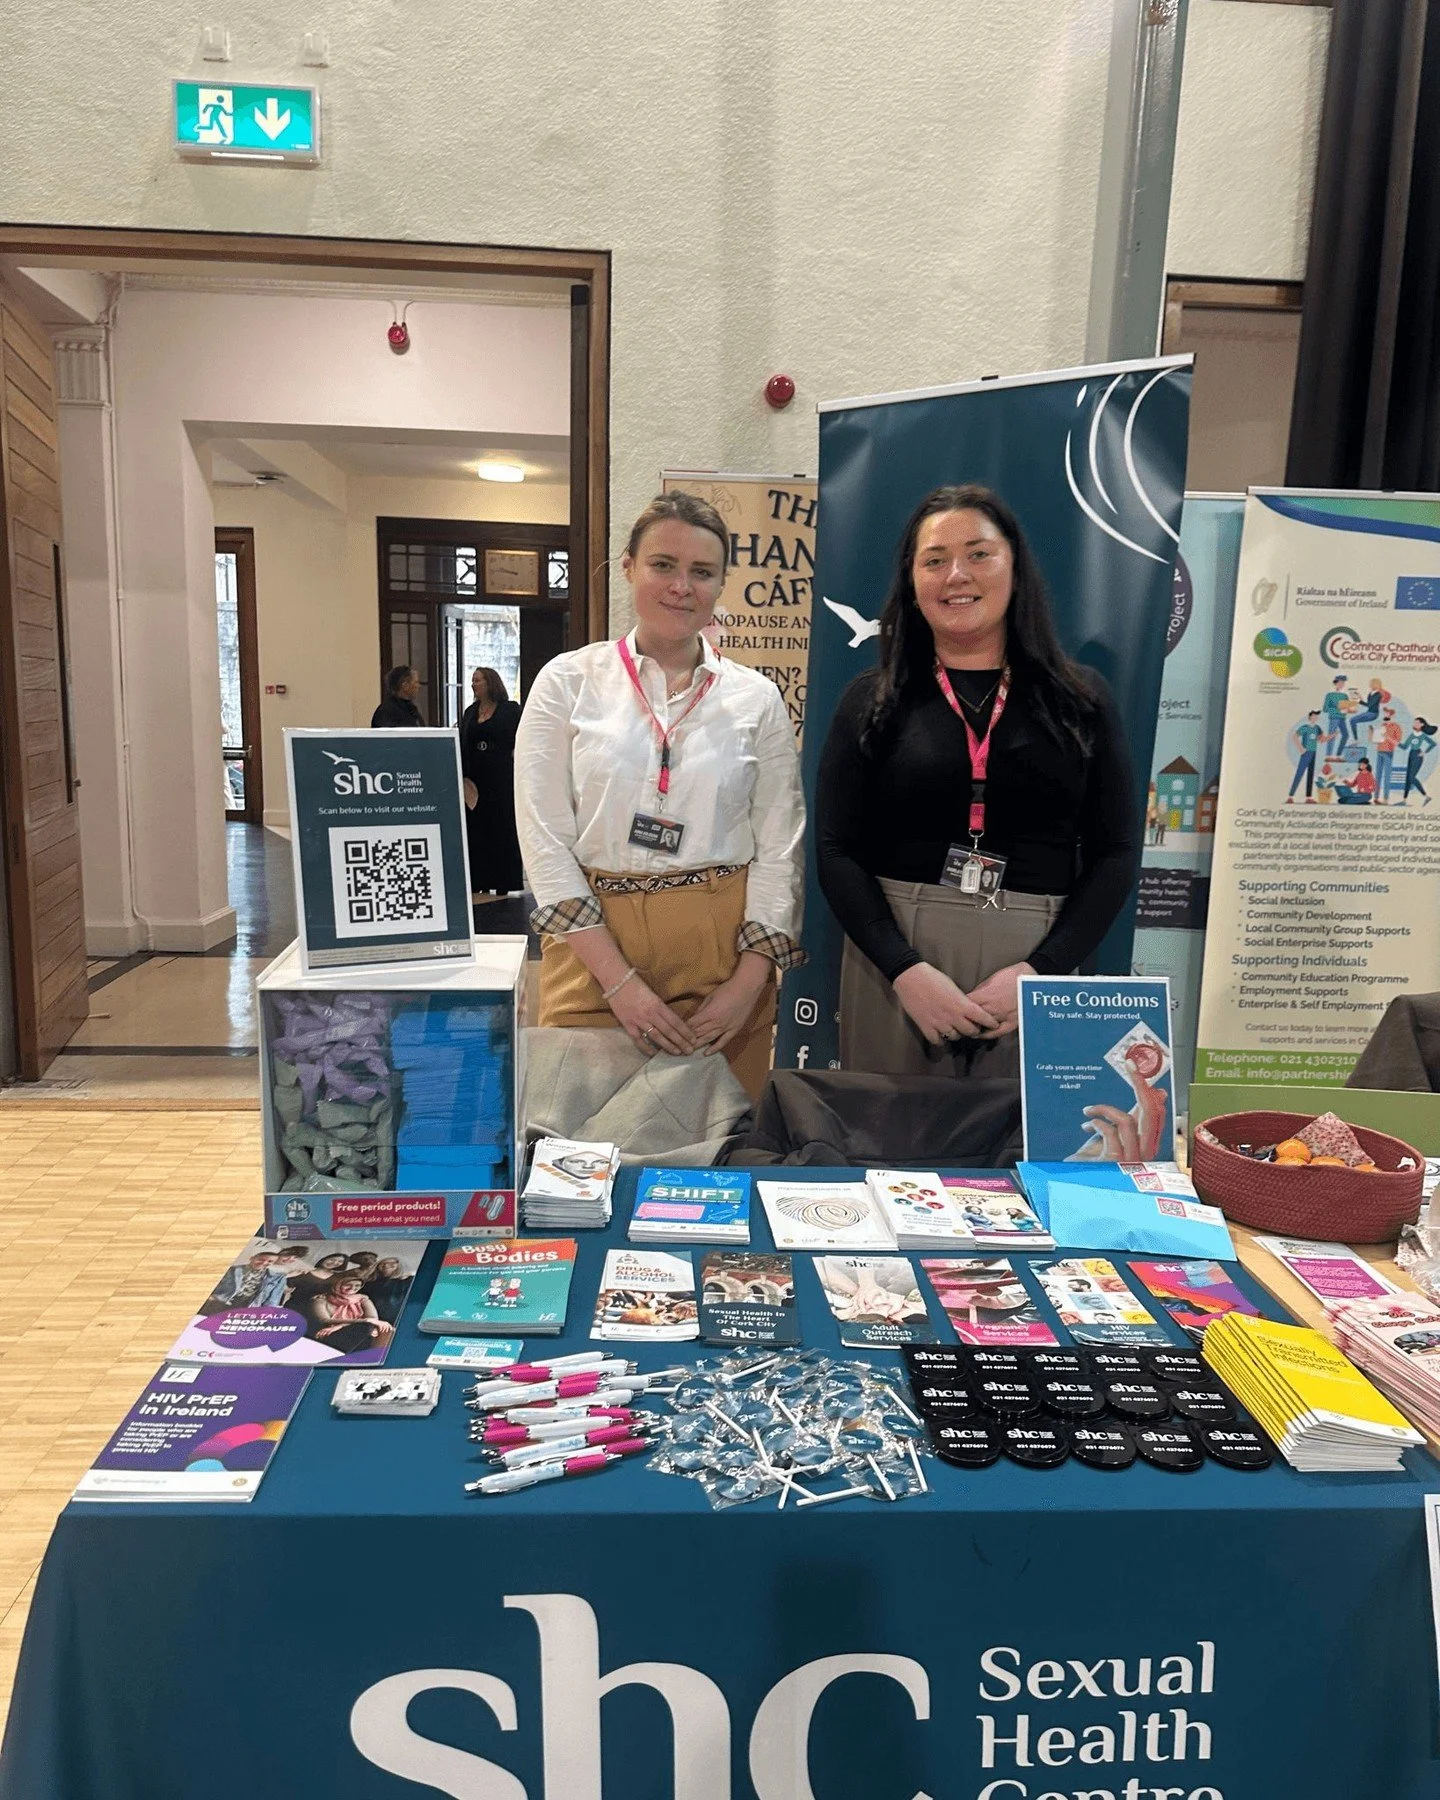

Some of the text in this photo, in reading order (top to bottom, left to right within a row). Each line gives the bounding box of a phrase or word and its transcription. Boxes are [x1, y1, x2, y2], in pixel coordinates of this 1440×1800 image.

[745, 574, 814, 607] CÁF
[1296, 599, 1388, 608] Government of Ireland
[719, 636, 783, 650] HEALTH
[1342, 641, 1434, 652] Comhar Chathair
[1341, 652, 1362, 661] Cork
[1364, 652, 1388, 663] City
[333, 765, 394, 795] shc
[397, 771, 421, 780] Sexual
[397, 779, 422, 787] Health
[398, 786, 424, 794] Centre
[318, 807, 337, 815] Scan
[339, 806, 363, 814] below
[1236, 808, 1406, 820] Cork City Partnership delivers Social
[1234, 818, 1380, 831] Community Activation Programme
[1244, 830, 1428, 843] This programme aims tackle poverty and
[1239, 879, 1389, 894] Supporting Communities
[1248, 896, 1325, 906] Social Inclusion
[1247, 910, 1372, 922] Community Development
[1246, 924, 1411, 936] Local Community Group Supports
[1244, 937, 1373, 950] Social Enterprise Supports
[1232, 954, 1367, 968] Supporting Individuals
[1242, 972, 1409, 985] Community Education Programme
[1240, 986, 1348, 998] Employment Supports
[1032, 991, 1159, 1008] Free Condoms
[1238, 1000, 1288, 1011] Enterprise
[1290, 1000, 1297, 1009] &
[1299, 1000, 1319, 1010] Self
[1322, 1001, 1384, 1012] Employment
[1049, 1011, 1067, 1020] Stay
[1086, 1012, 1102, 1020] Stay
[1104, 1012, 1142, 1020] protected.
[1245, 1023, 1313, 1033] Contact today
[1260, 1036, 1347, 1046] supports and services
[1207, 1052, 1357, 1066] Telephone: 021 4302310
[1206, 1068, 1242, 1078] Email:
[652, 1187, 735, 1200] SHIFT
[337, 1201, 440, 1213] Free period products!
[338, 1216, 362, 1224] Please
[384, 1215, 402, 1223] what
[404, 1216, 418, 1224] you
[462, 1244, 507, 1254] Busy
[476, 1251, 558, 1263] Bodies
[616, 1270, 675, 1278] ALCOHOL
[720, 1327, 757, 1338] shc
[973, 1323, 1029, 1332] Pregnancy
[914, 1352, 943, 1361] shc
[973, 1353, 1003, 1361] shc
[1034, 1354, 1063, 1363] shc
[1095, 1355, 1124, 1363] shc
[1155, 1355, 1184, 1364] shc
[983, 1382, 1013, 1391] shc
[1047, 1382, 1077, 1391] shc
[1110, 1383, 1141, 1393] shc
[922, 1388, 953, 1398] shc
[1177, 1391, 1208, 1400] shc
[147, 1393, 238, 1405] HIV PrEP
[163, 1406, 233, 1417] Ireland
[940, 1428, 972, 1438] shc
[1007, 1428, 1039, 1439] shc
[1075, 1430, 1108, 1440] shc
[1142, 1432, 1174, 1442] shc
[1209, 1431, 1241, 1441] shc
[979, 1641, 1215, 1701] Sexual
[349, 1592, 932, 1800] shc
[976, 1708, 1212, 1768] Health
